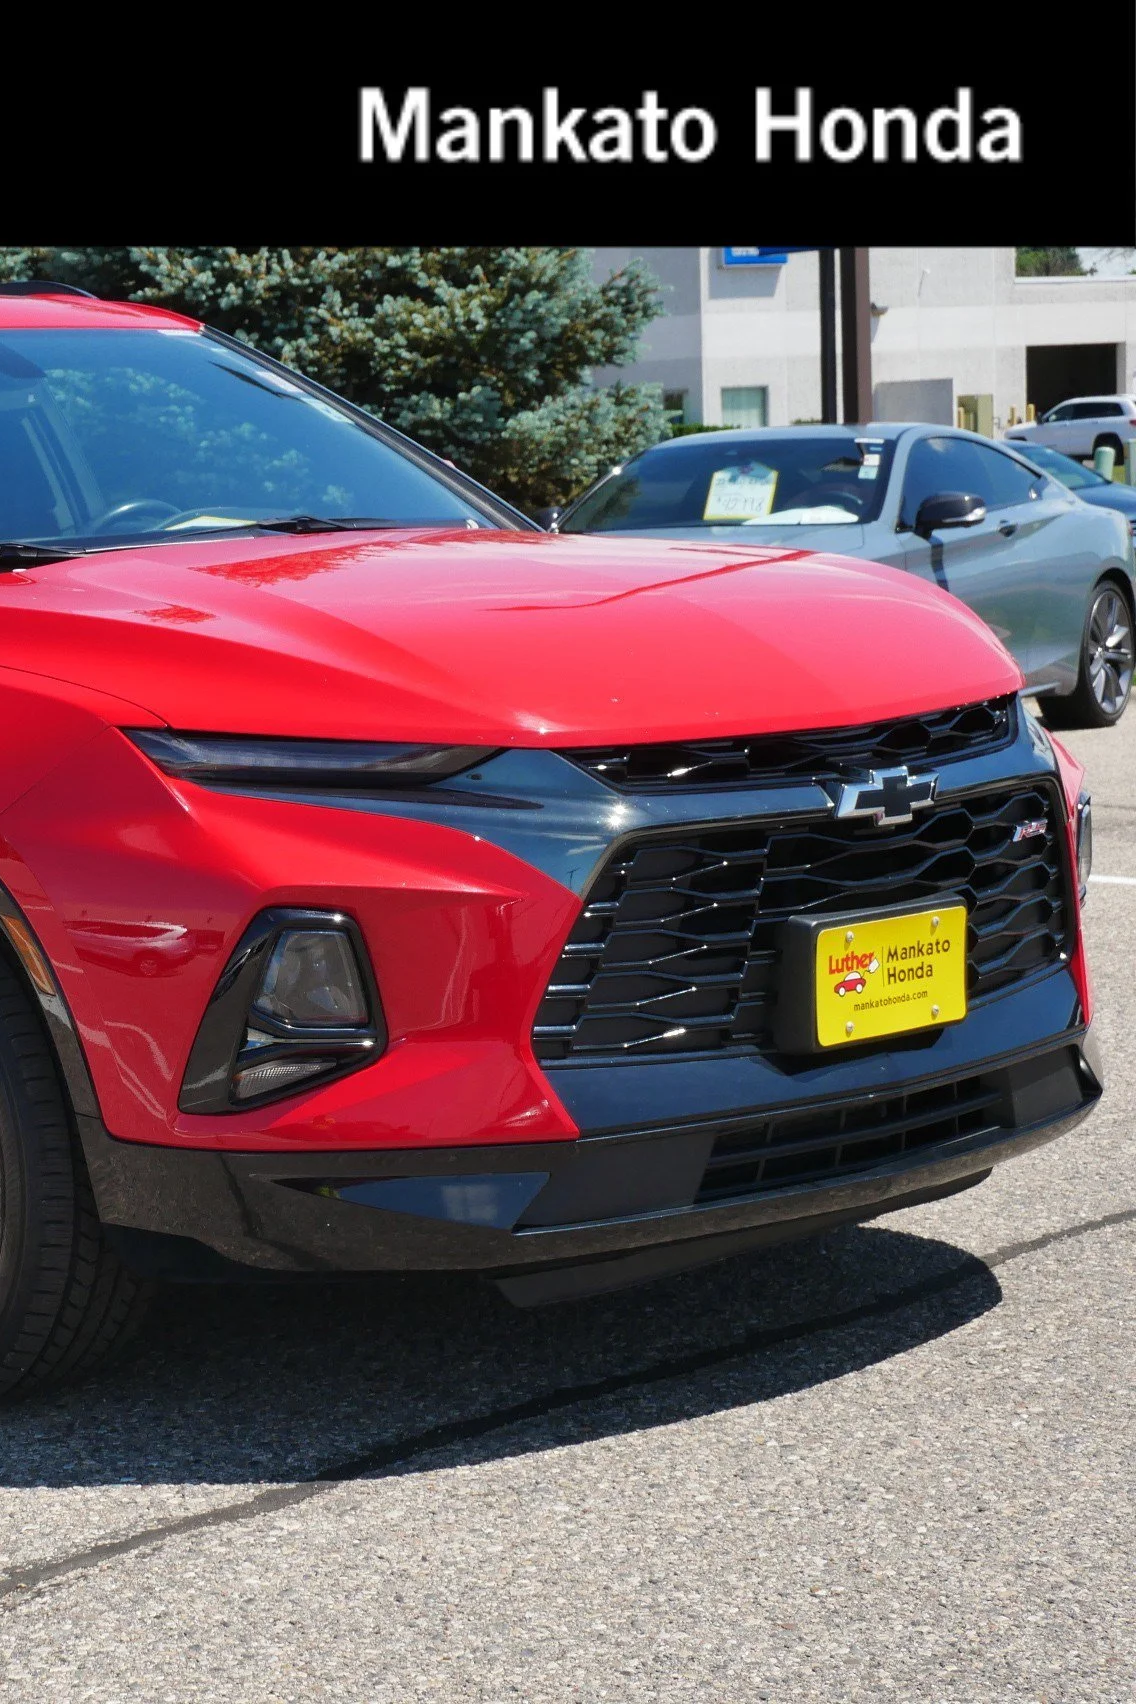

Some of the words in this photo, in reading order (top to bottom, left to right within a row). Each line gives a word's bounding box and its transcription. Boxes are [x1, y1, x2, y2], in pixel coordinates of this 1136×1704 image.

[886, 939, 950, 963] Mankato
[828, 951, 874, 975] Luther
[887, 962, 933, 984] Honda
[853, 990, 928, 1011] mankatohonda.com
